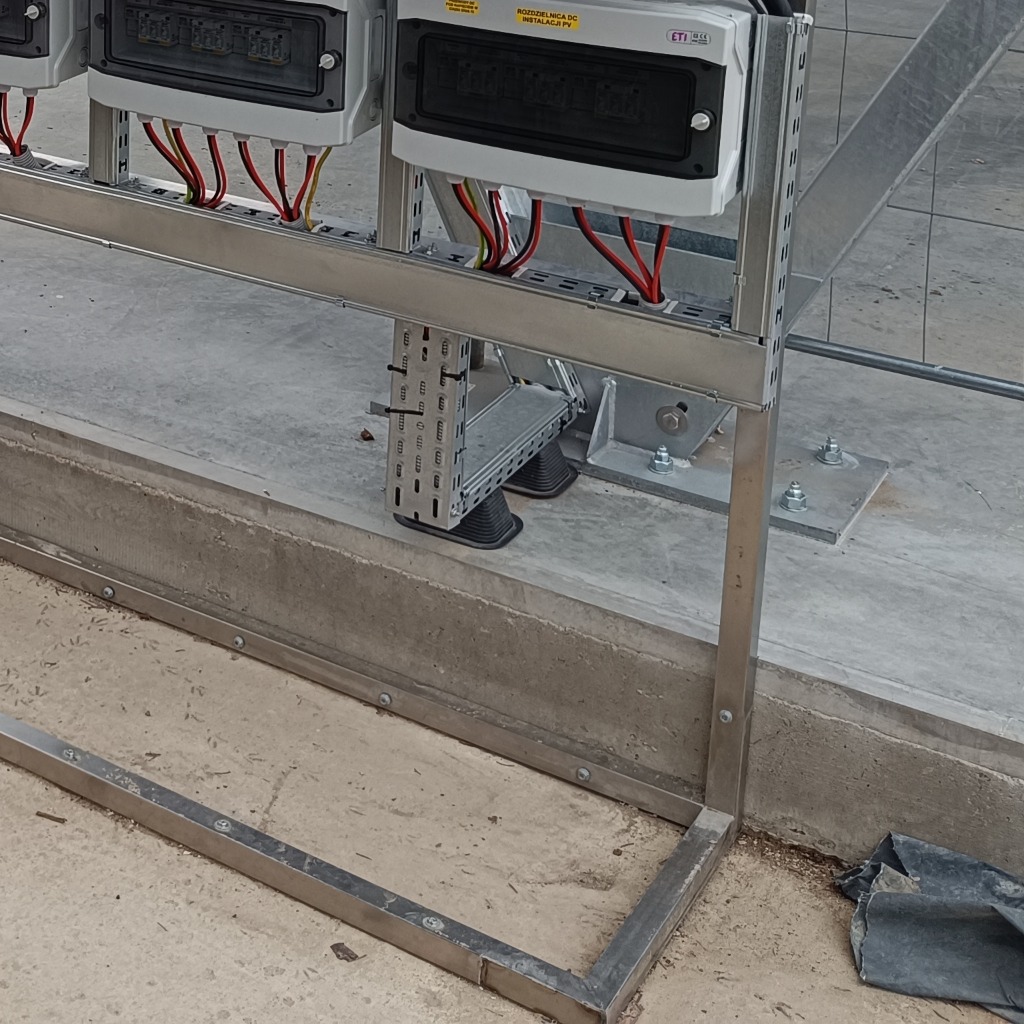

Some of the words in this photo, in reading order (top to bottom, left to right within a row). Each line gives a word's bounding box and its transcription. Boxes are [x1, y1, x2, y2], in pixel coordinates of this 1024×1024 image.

[516, 8, 566, 20] ROZDZIELNICA
[567, 14, 578, 22] DC
[522, 16, 561, 27] INSTALACJI
[671, 31, 688, 42] ETI
